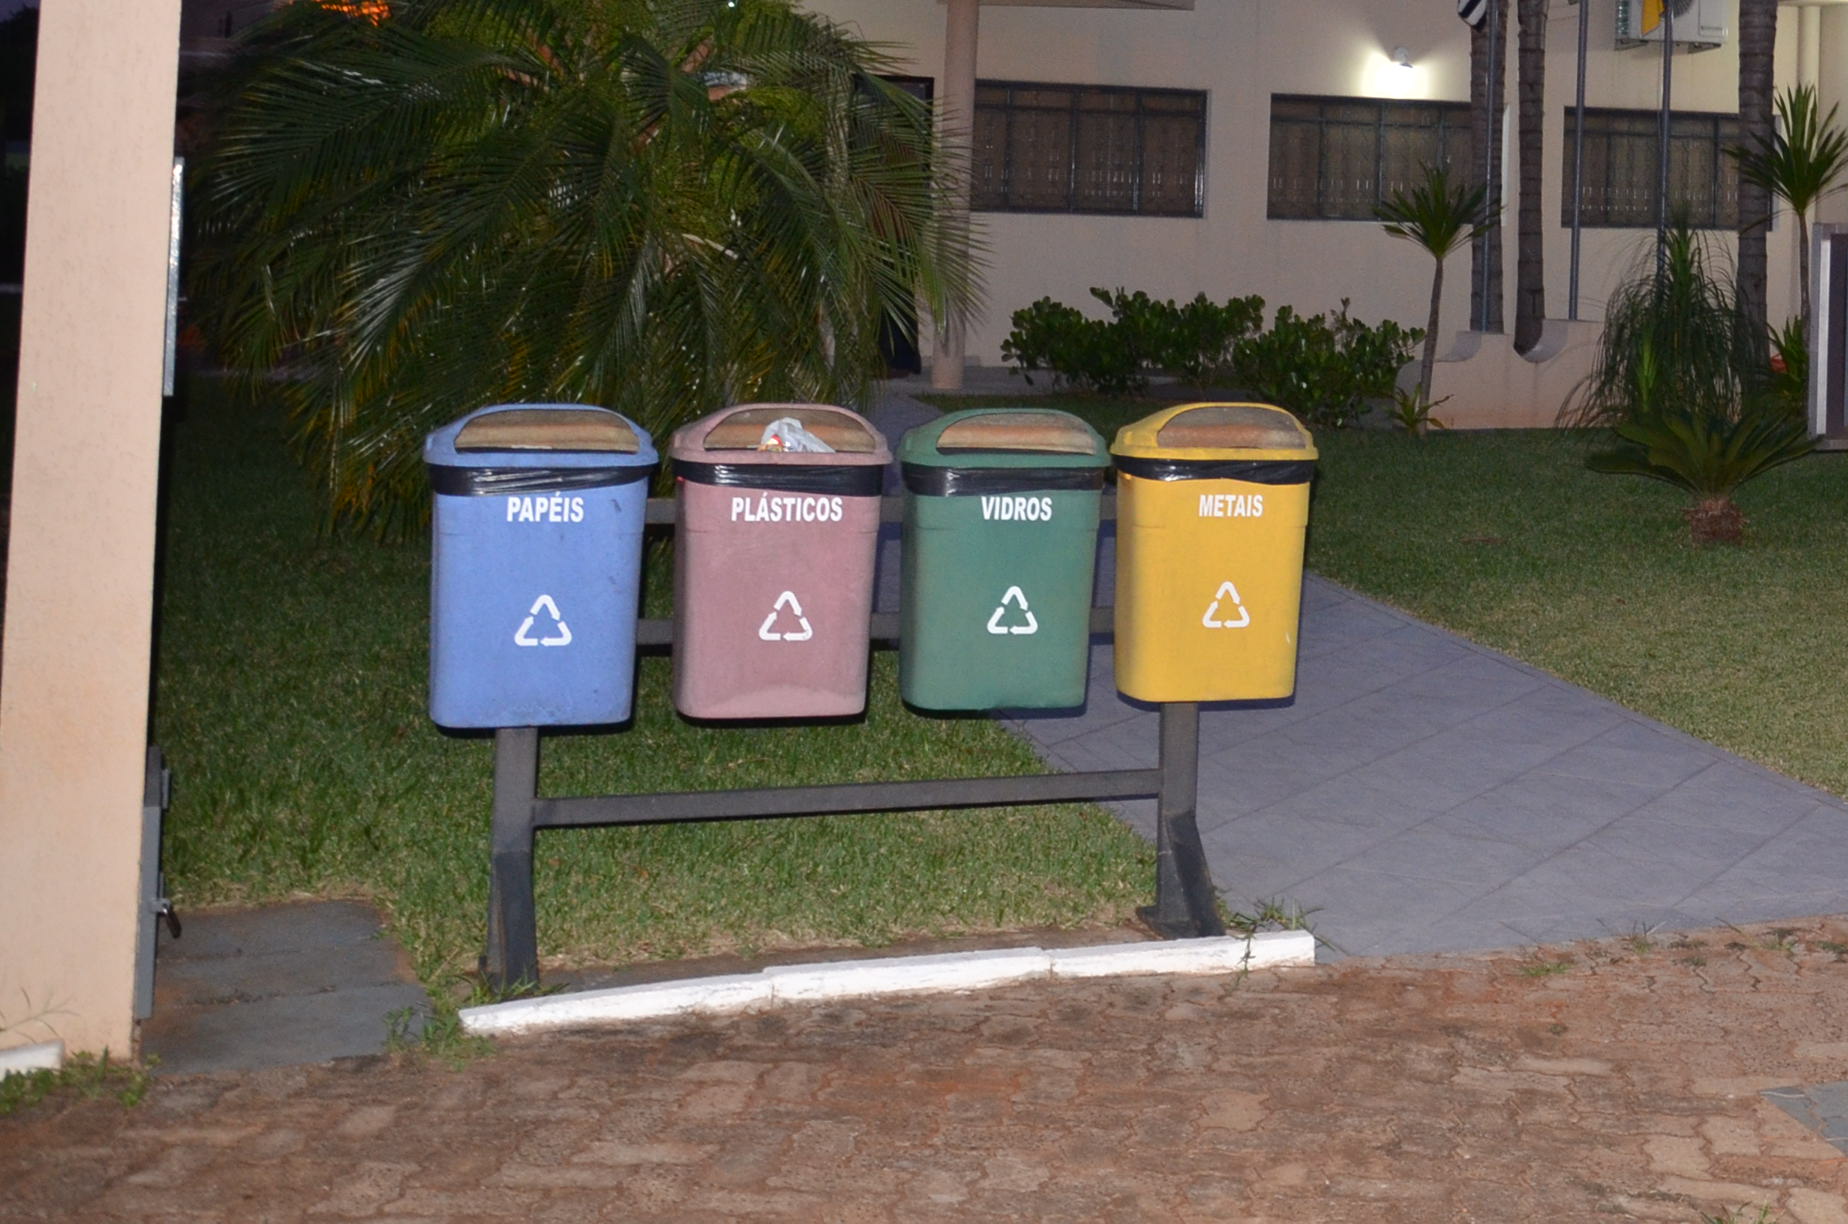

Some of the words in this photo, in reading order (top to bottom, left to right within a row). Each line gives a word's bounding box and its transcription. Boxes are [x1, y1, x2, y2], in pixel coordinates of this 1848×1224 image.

[506, 491, 584, 523] PAPÉIS
[731, 491, 843, 522] PLÁSTICOS
[981, 496, 1053, 521] VIDROS
[1199, 494, 1264, 518] METAIS
